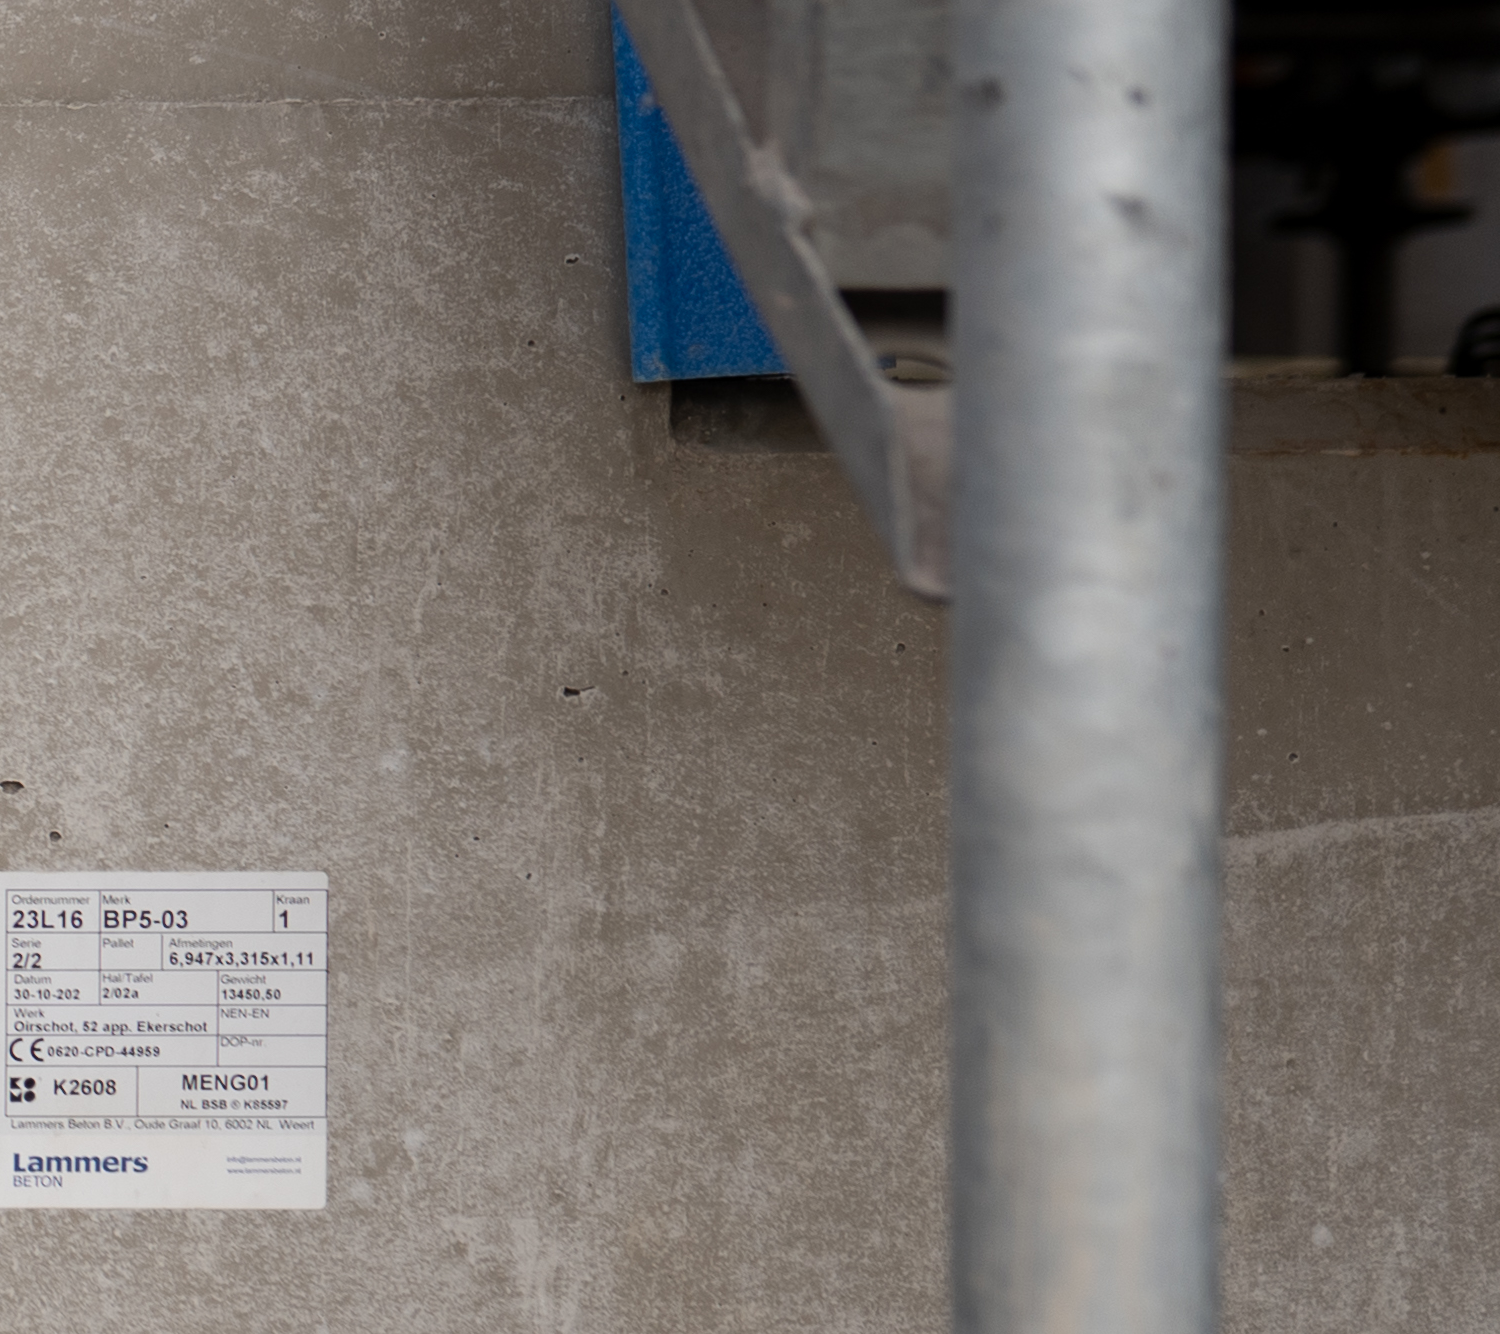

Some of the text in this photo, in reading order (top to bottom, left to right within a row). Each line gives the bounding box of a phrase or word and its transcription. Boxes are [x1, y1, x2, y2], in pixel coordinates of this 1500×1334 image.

[11, 894, 90, 905] Ordernummer
[102, 895, 131, 905] Merk
[276, 894, 311, 905] Kraan
[12, 910, 84, 929] 23L16
[103, 910, 189, 929] BP5-03
[279, 909, 289, 929] 1
[11, 938, 41, 948] Serie
[102, 938, 134, 948] Pallet
[169, 938, 233, 951] Afmetingen
[12, 952, 42, 968] 2/2
[169, 952, 314, 968] 6,947x3,315x1,11
[14, 973, 52, 984] Datum
[220, 974, 266, 985] Gewicht
[14, 988, 81, 1000] 30-10-202
[102, 987, 139, 999] 2/02a
[221, 988, 282, 1002] 13450,50
[13, 1008, 45, 1019] Werk
[220, 1008, 270, 1018] NEN-EN
[13, 1020, 208, 1036] Oirschot, 52 app. Ekerschot
[47, 1046, 161, 1058] 0620-CPD-44959
[53, 1079, 117, 1096] K2608
[181, 1074, 270, 1091] MENG01
[180, 1099, 198, 1110] NL
[202, 1099, 228, 1110] BSB
[10, 1119, 65, 1130] Lammers
[68, 1119, 100, 1130] Beton
[256, 1119, 273, 1130] NL
[13, 1153, 149, 1173] Lammers
[13, 1175, 63, 1188] BETON
